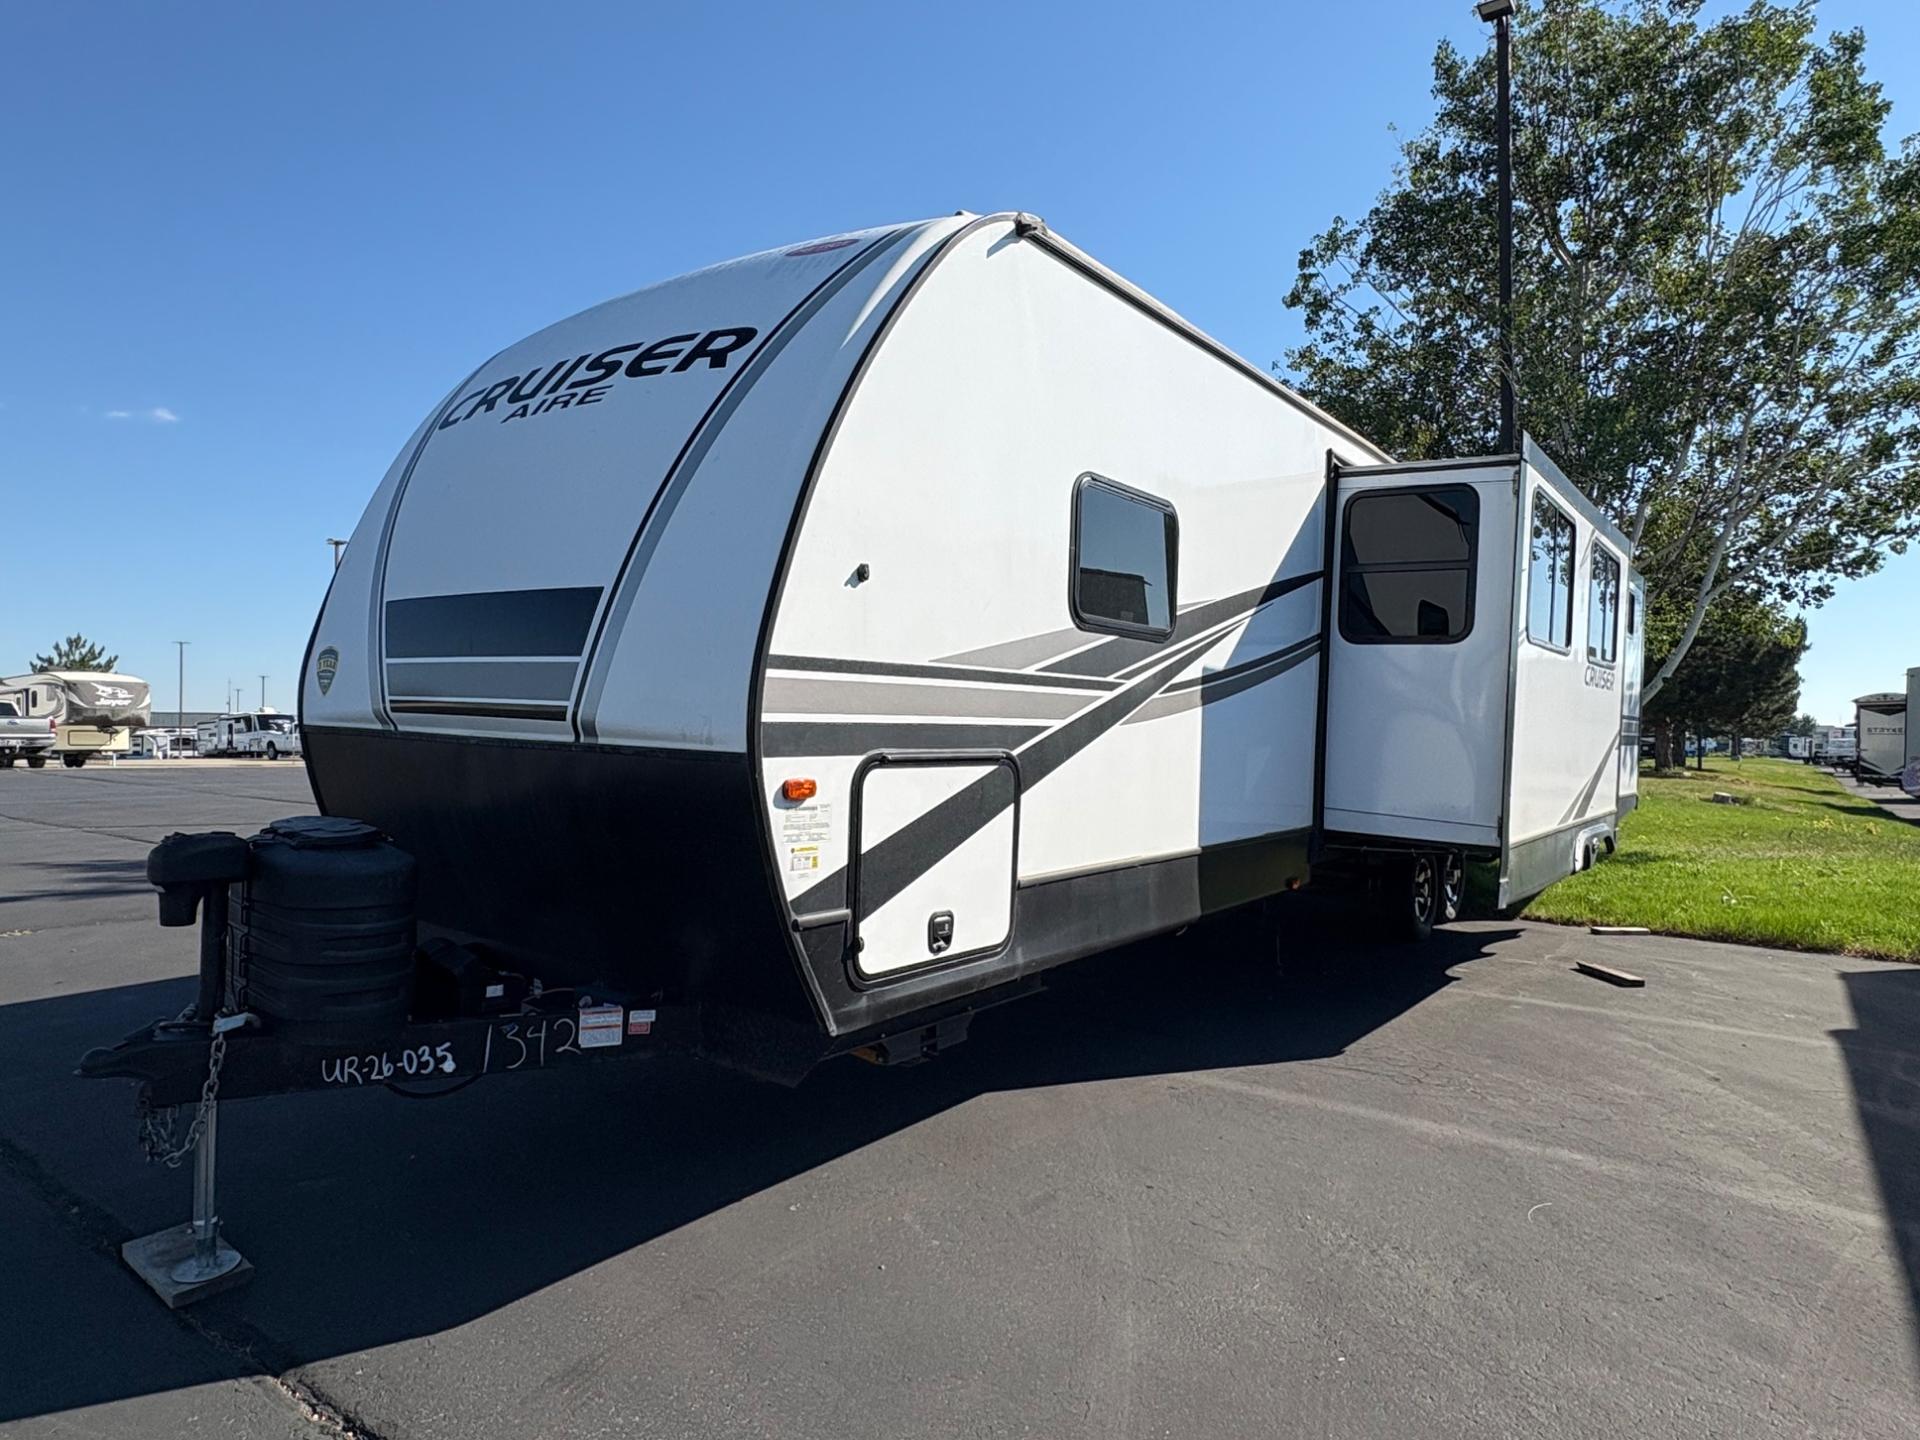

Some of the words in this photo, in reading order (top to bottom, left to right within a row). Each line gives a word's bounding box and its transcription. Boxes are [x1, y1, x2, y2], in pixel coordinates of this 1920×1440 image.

[438, 326, 759, 431] CRUISER
[500, 384, 614, 425] AIRE
[1584, 665, 1615, 691] CRUISER
